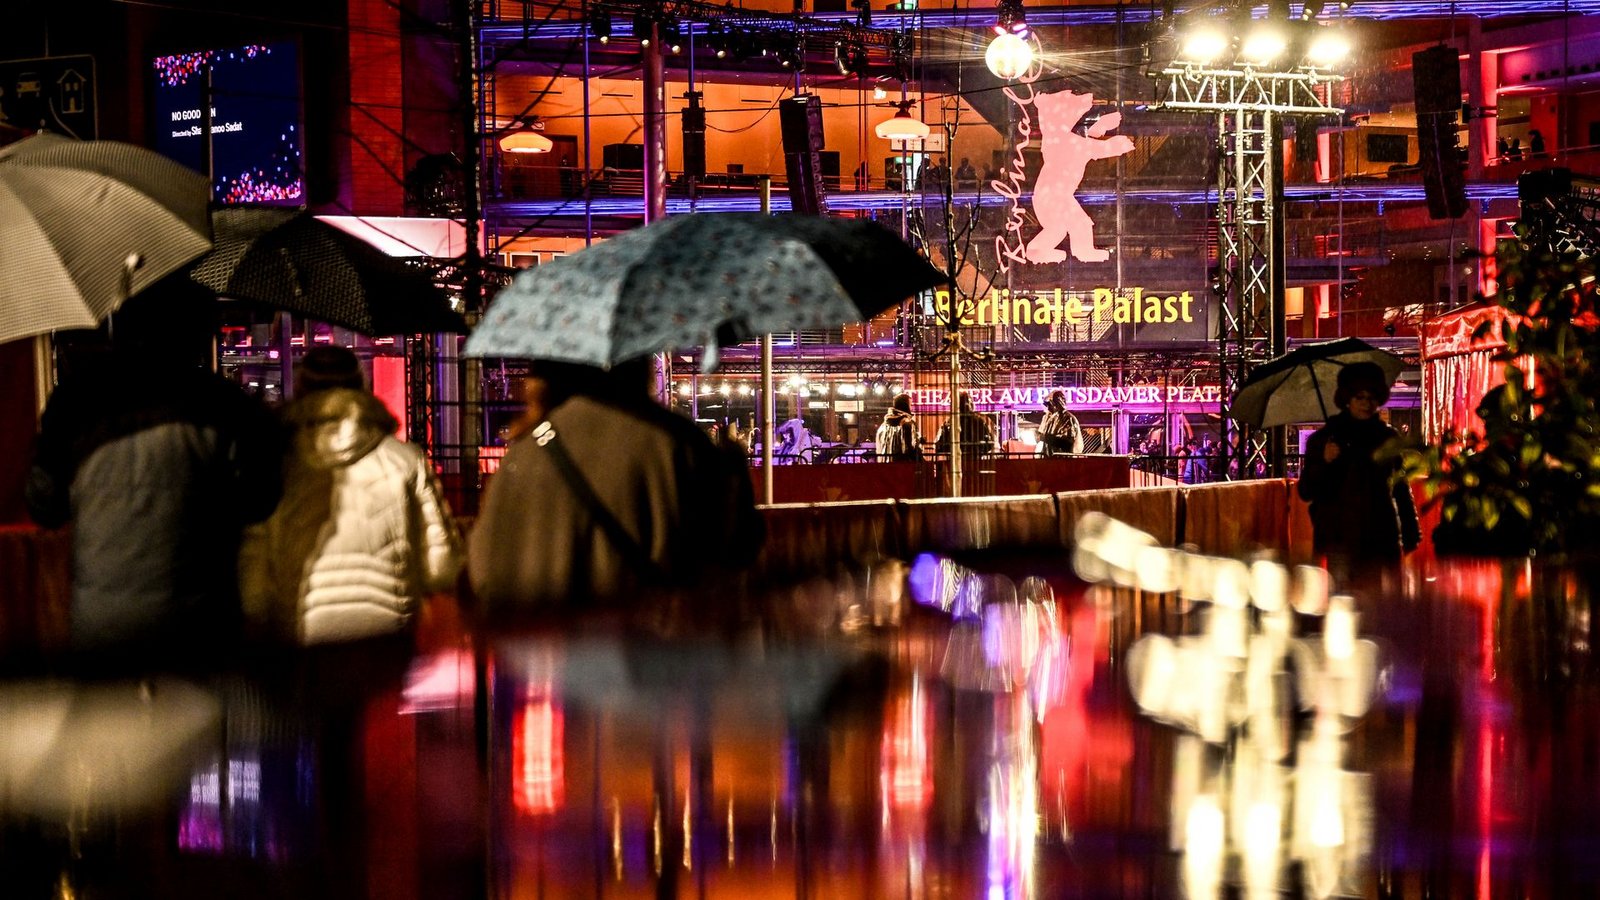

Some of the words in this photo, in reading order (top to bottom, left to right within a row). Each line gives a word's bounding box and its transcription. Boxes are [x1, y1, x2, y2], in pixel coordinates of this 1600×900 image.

[172, 112, 181, 121] NO
[182, 110, 201, 120] GOOD
[225, 122, 242, 132] Sadat
[935, 287, 1082, 326] Berlinale
[1093, 287, 1194, 325] Palast
[904, 387, 995, 406] THEAER
[1000, 387, 1032, 405] AM
[1036, 386, 1162, 404] PTSDAMER
